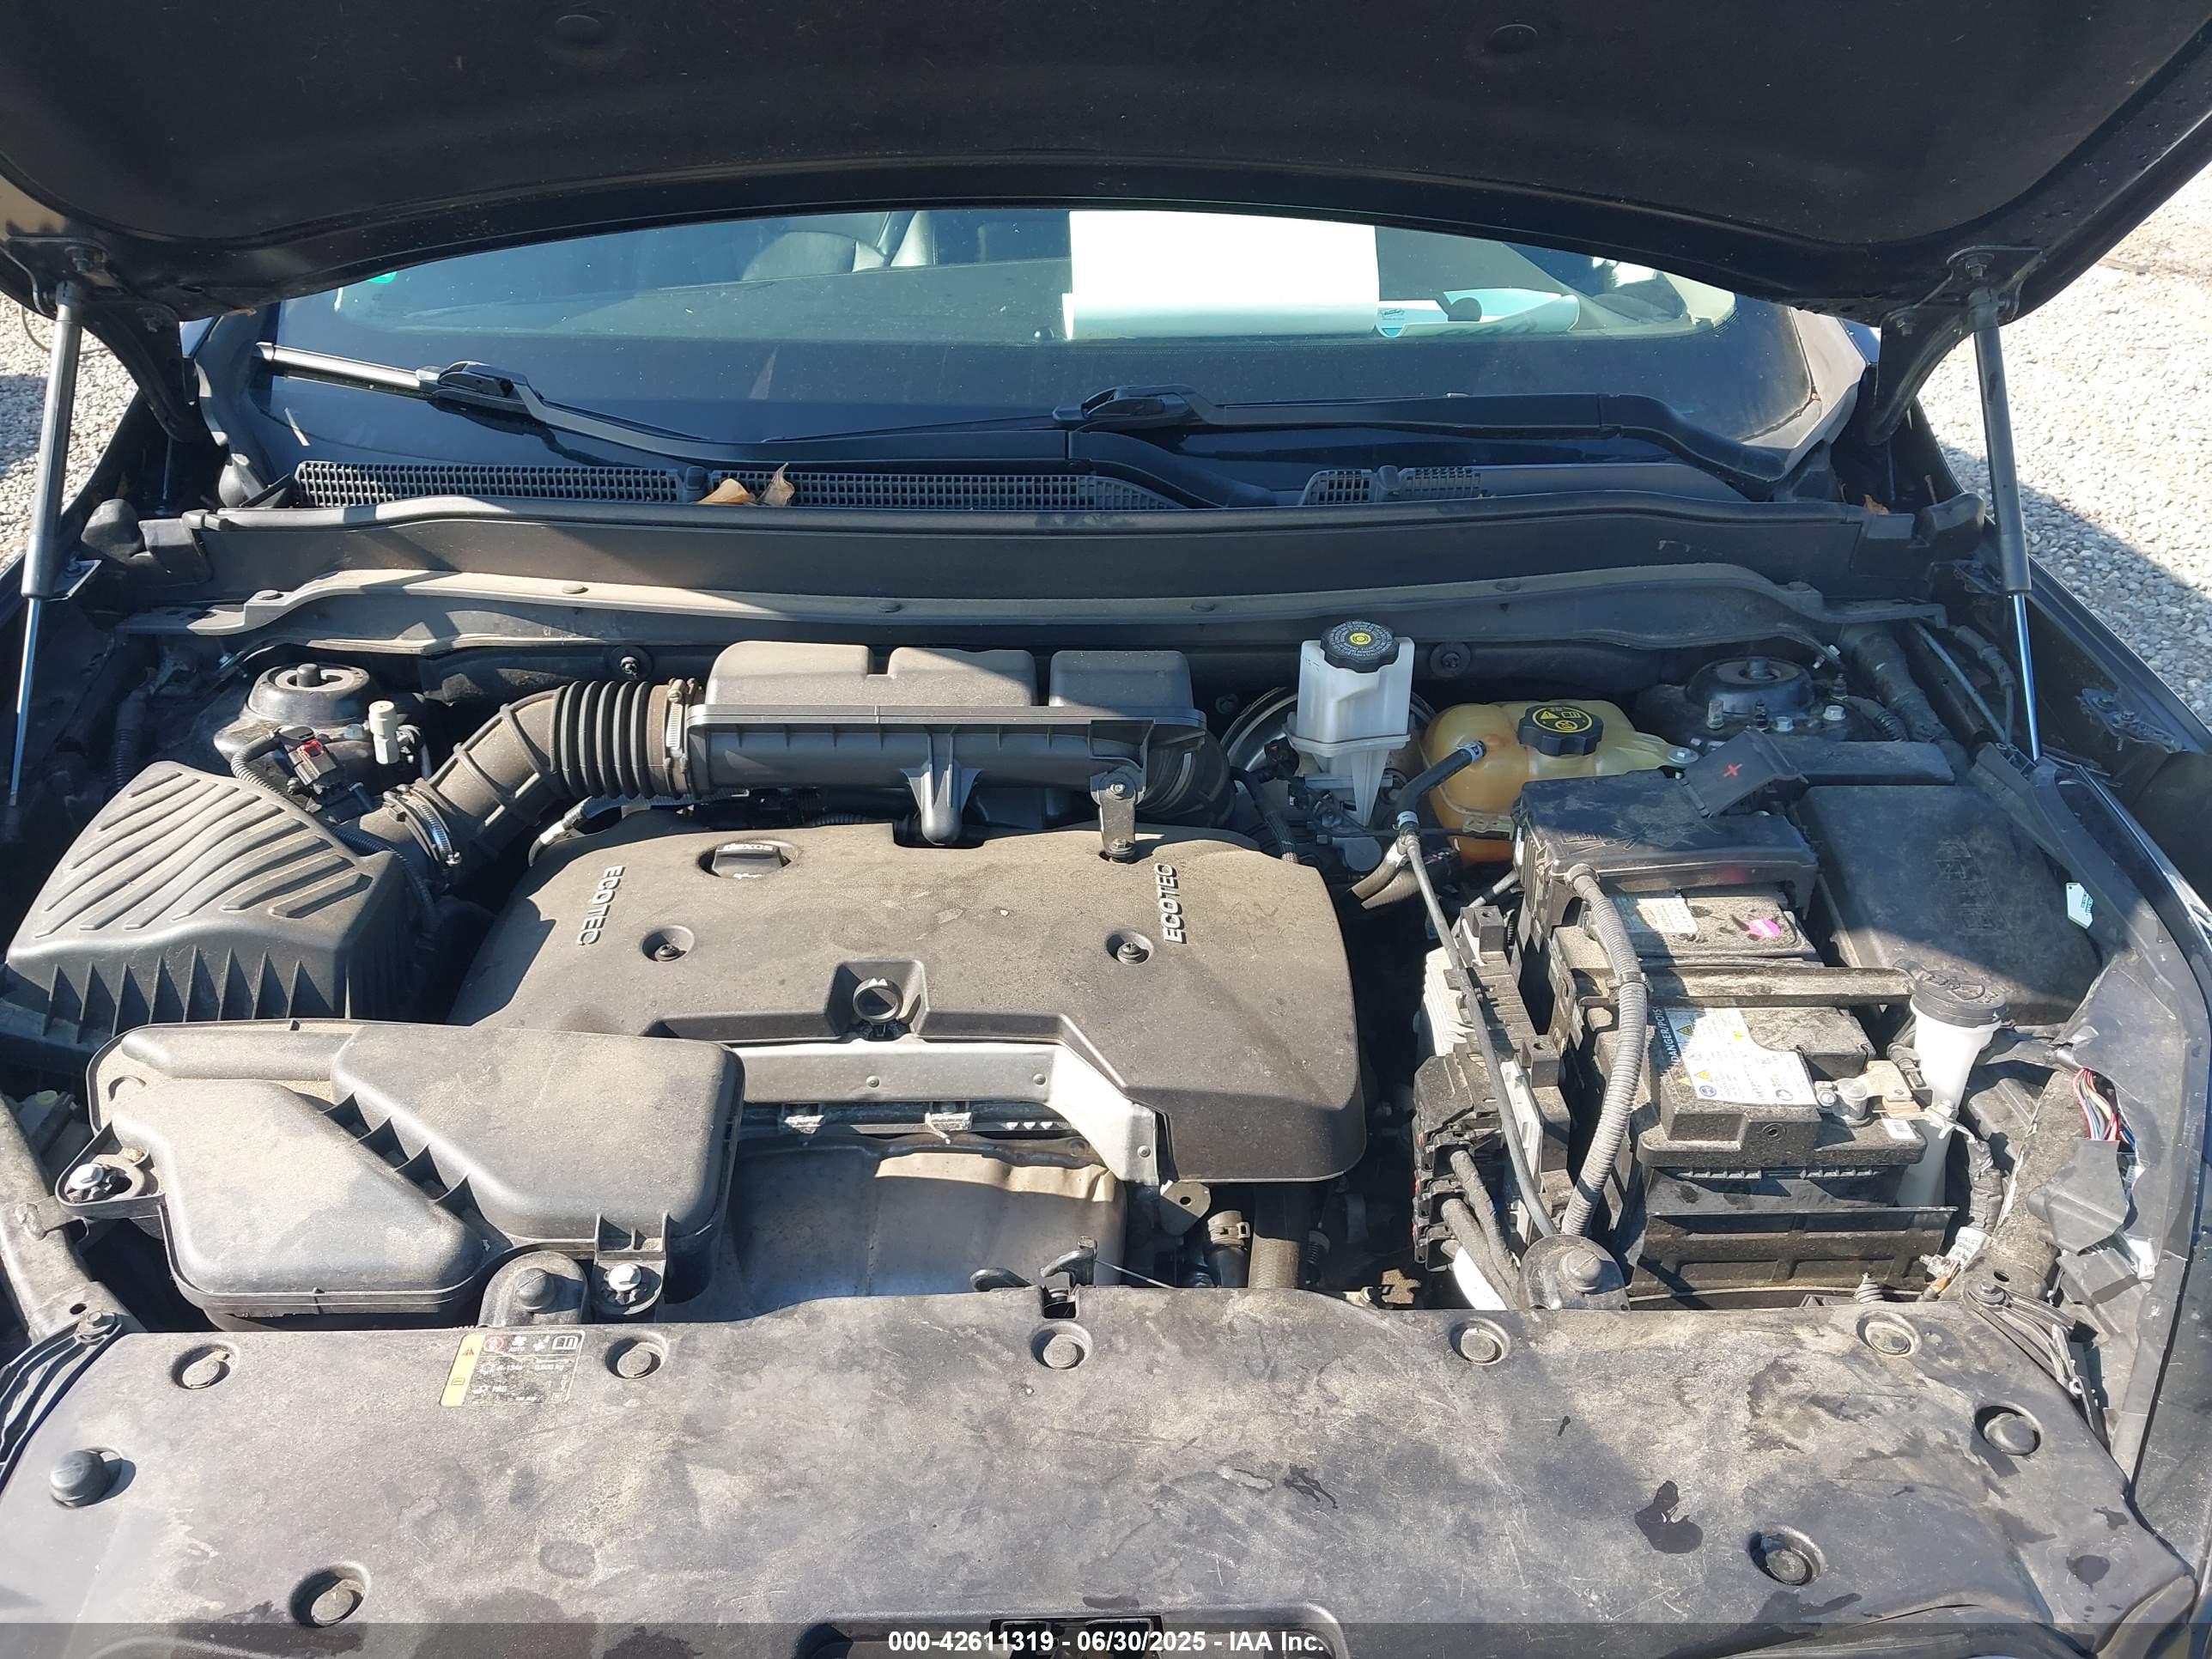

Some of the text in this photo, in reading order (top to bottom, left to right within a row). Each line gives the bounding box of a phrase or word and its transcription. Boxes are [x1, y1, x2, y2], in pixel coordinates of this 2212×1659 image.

[722, 842, 774, 852] dexos
[577, 866, 624, 945] ECOTEC
[1154, 863, 1186, 943] ECOTEC
